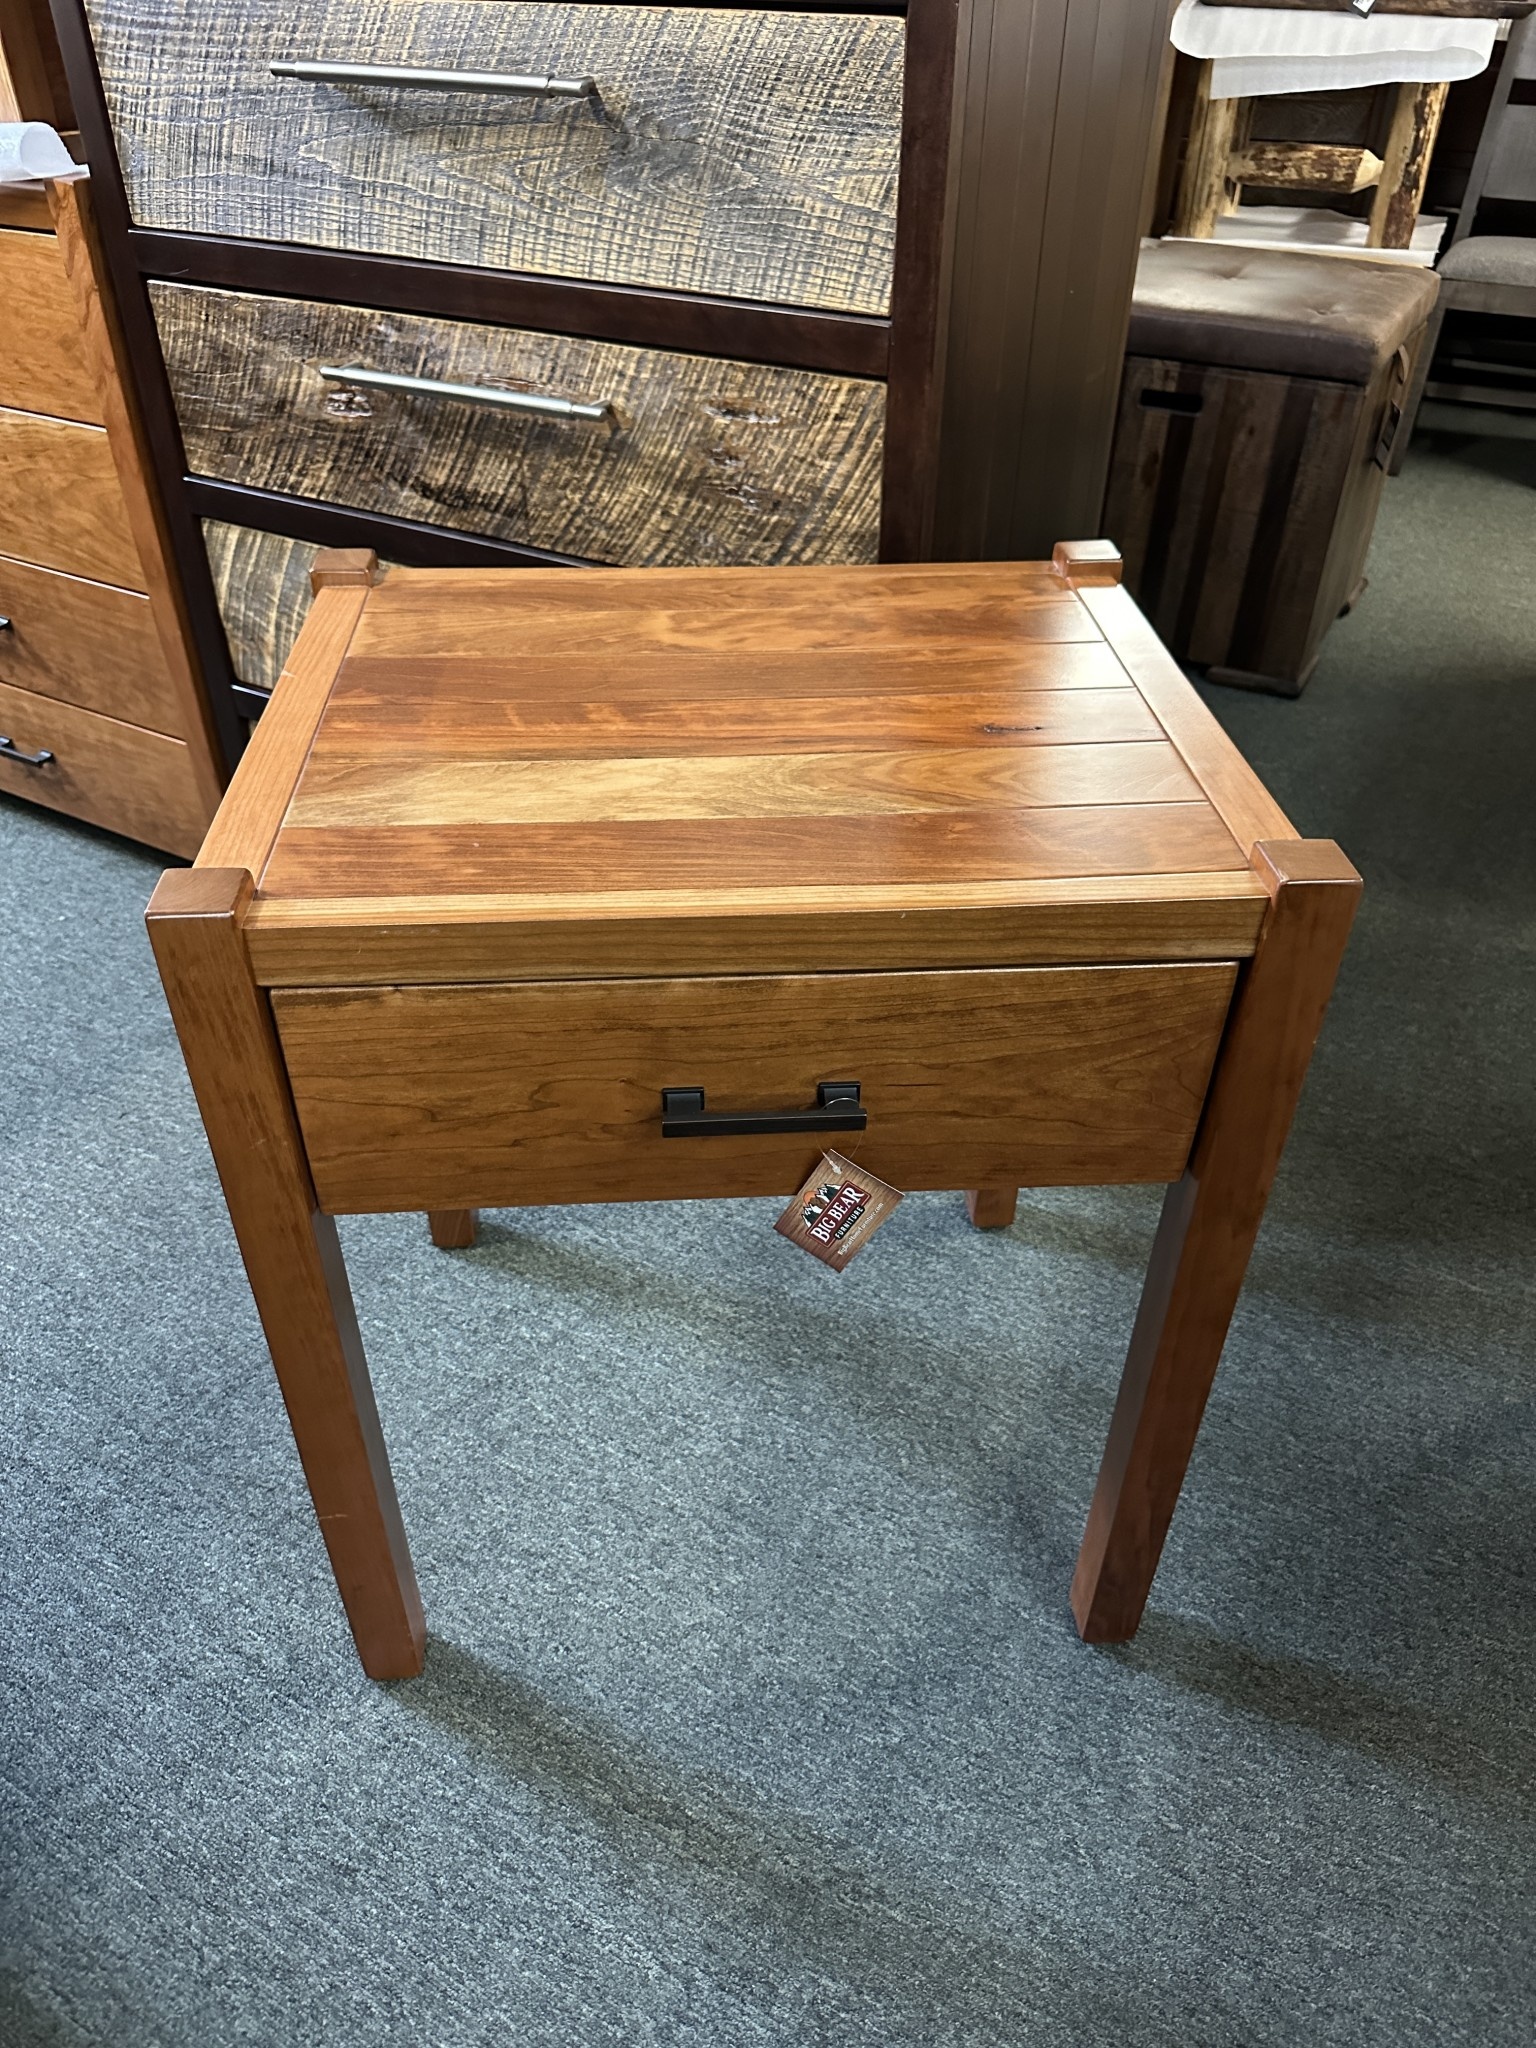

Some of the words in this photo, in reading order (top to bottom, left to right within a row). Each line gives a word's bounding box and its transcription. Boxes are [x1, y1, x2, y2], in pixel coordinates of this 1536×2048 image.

[810, 1217, 836, 1243] BIG
[828, 1187, 865, 1222] BEAR
[834, 1207, 864, 1239] FURNITURE
